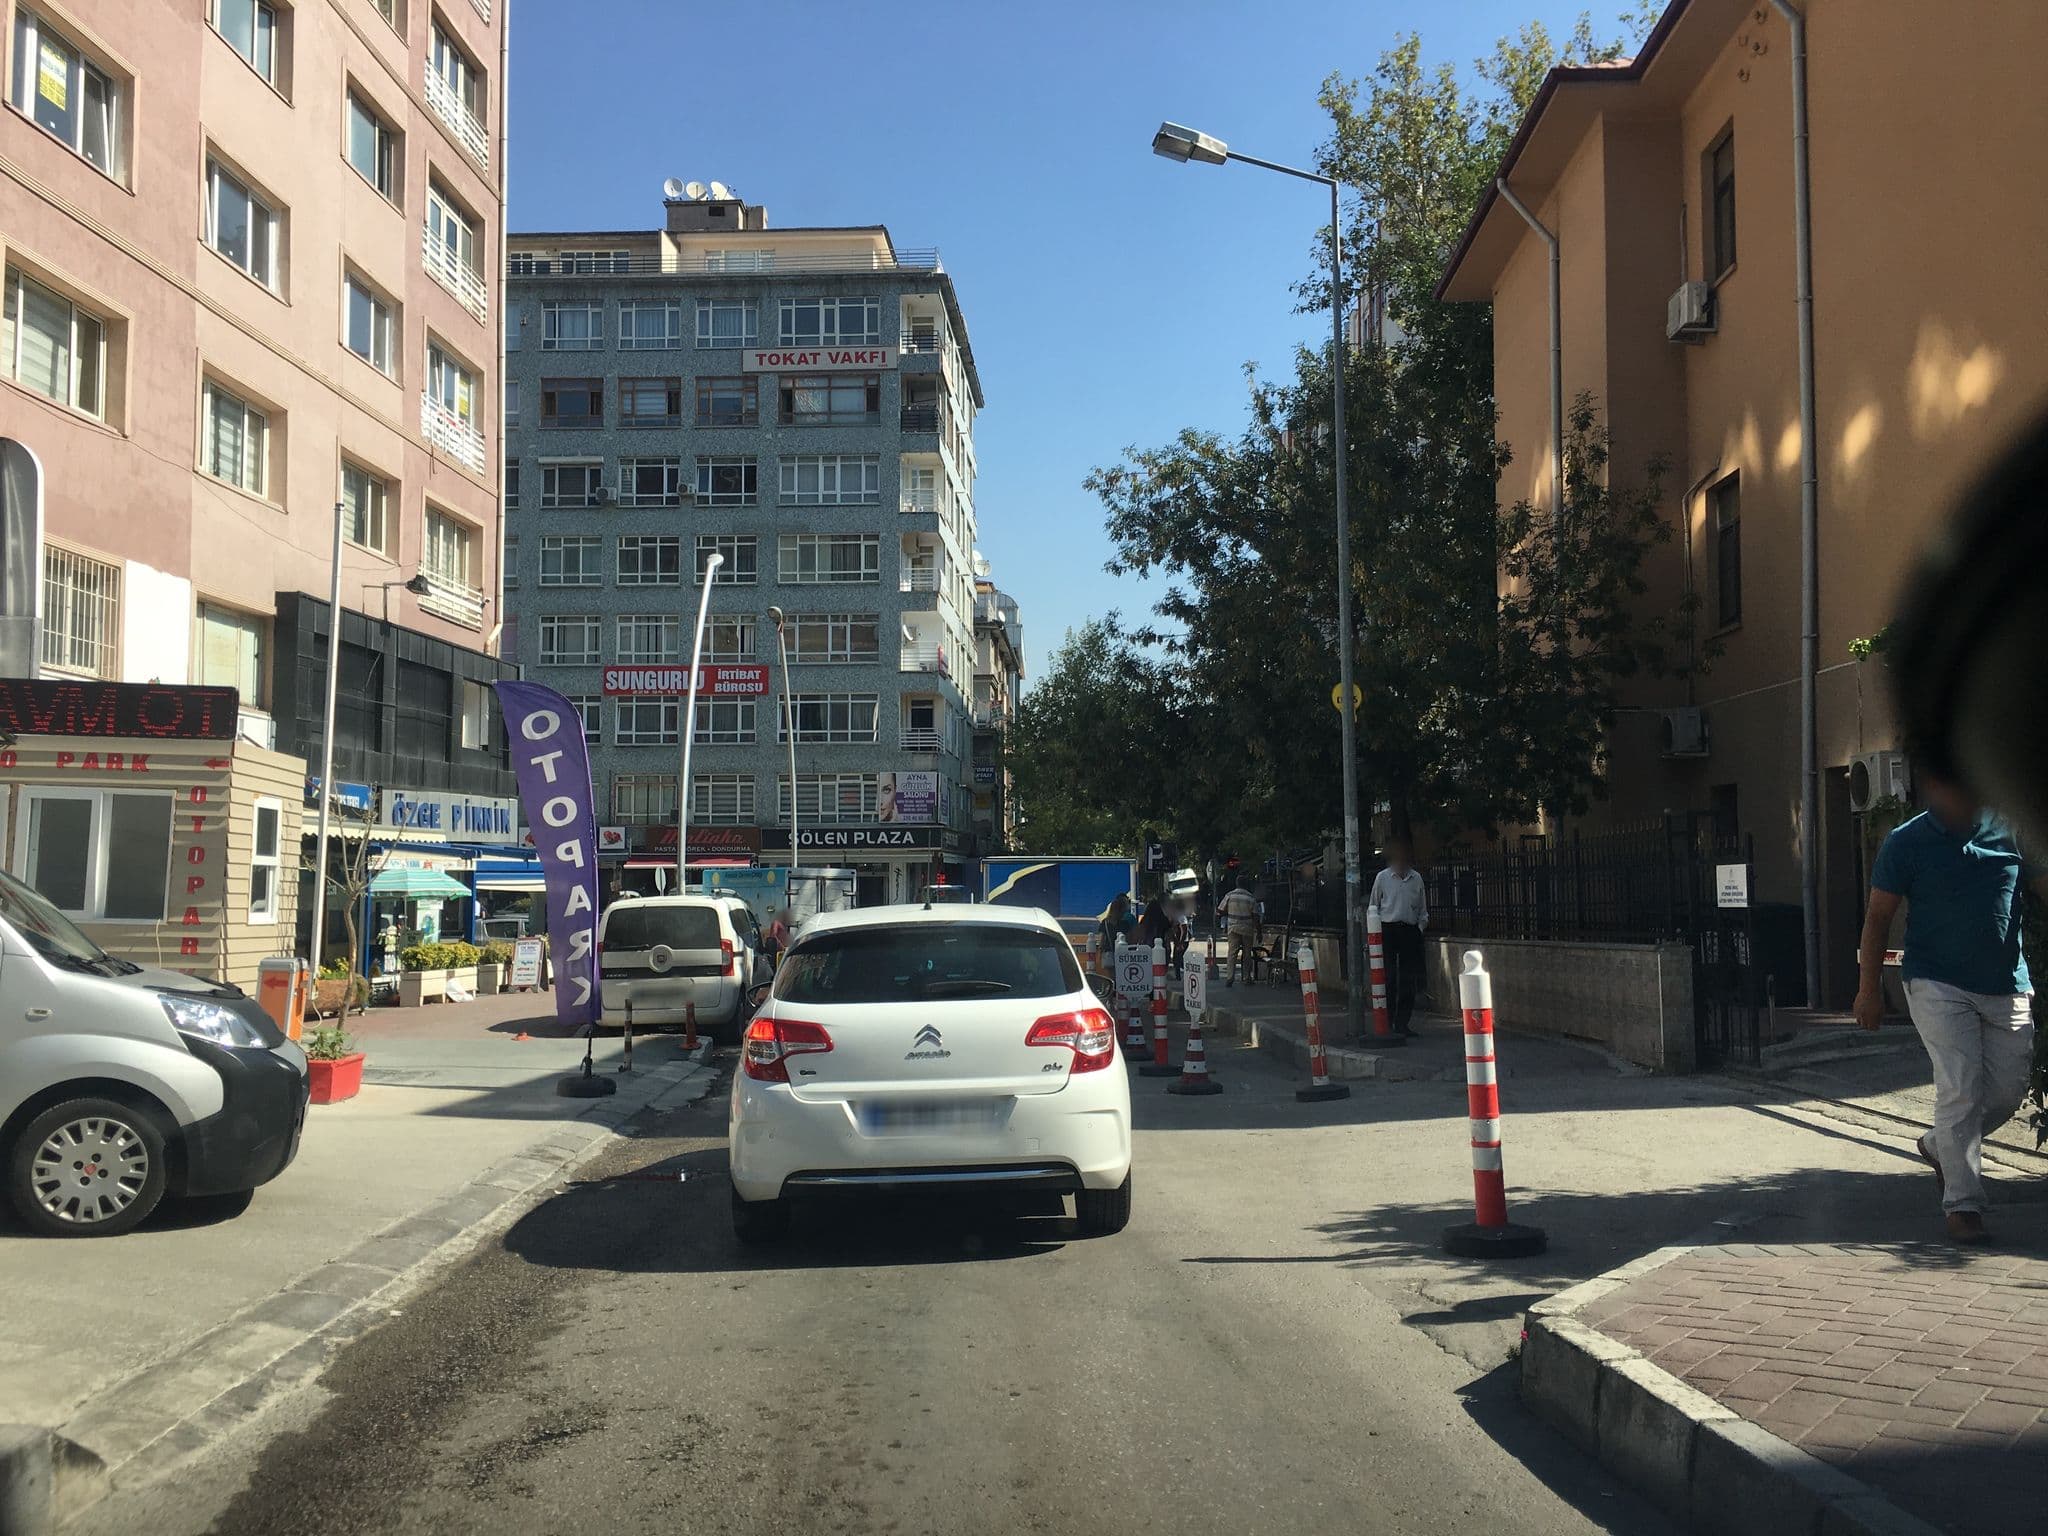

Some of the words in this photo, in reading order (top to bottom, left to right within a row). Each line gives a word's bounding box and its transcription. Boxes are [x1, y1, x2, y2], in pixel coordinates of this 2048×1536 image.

[755, 352, 821, 366] TOKAT
[828, 350, 886, 365] VAKFI
[605, 670, 704, 690] SUNGURLU
[717, 668, 761, 680] İRTİBAT
[714, 681, 763, 693] BÜROSU
[56, 751, 151, 772] PARK
[903, 791, 929, 799] SALONU
[392, 793, 441, 829] ÖZGE
[452, 798, 511, 834] PİKNİK
[853, 831, 915, 844] PLAZA
[179, 785, 208, 976] OTOPAR
[1118, 953, 1149, 963] SÜMER
